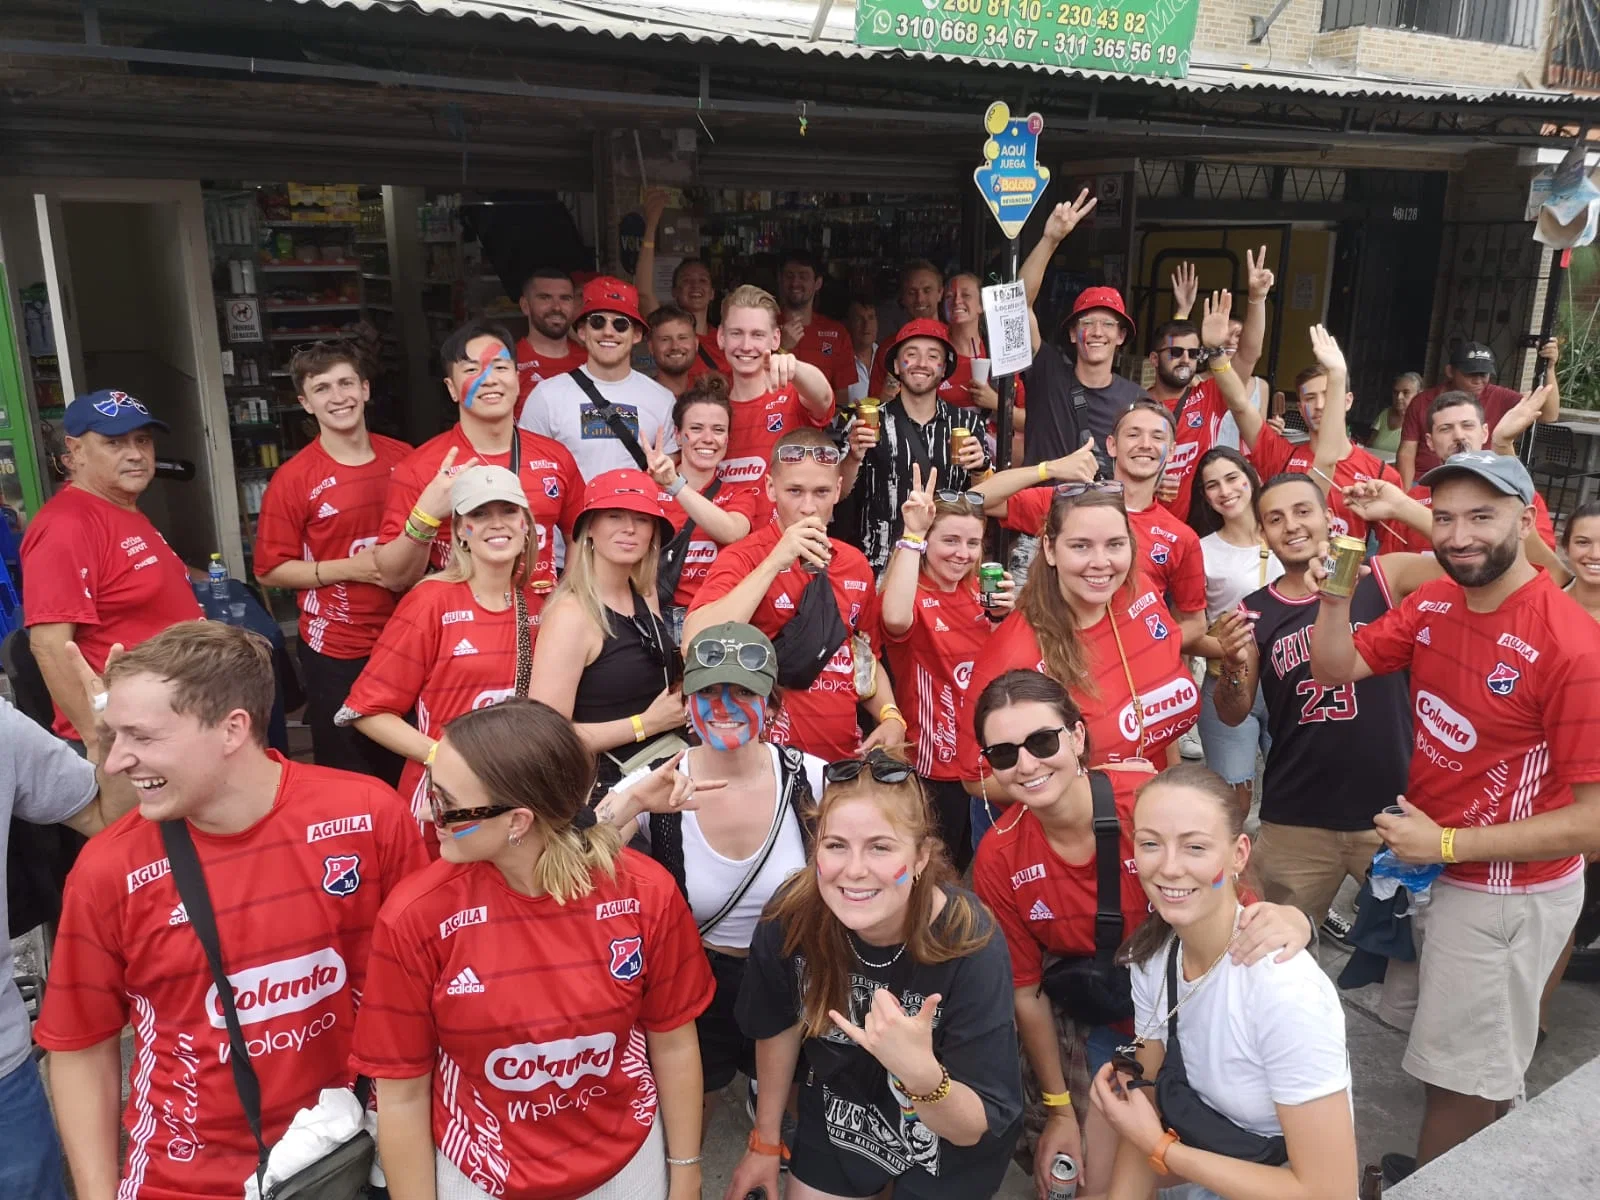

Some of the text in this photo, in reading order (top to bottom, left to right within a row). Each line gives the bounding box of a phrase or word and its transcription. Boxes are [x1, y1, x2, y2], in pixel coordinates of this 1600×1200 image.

[987, 0, 1010, 18] 81
[1018, 0, 1041, 21] 10
[1057, 3, 1092, 27] 230
[1096, 9, 1119, 30] 43
[1123, 12, 1146, 34] 82
[895, 14, 935, 39] 310
[940, 19, 979, 44] 668
[983, 24, 1009, 47] 34
[1013, 28, 1039, 50] 67
[1054, 32, 1088, 55] 311
[1092, 37, 1126, 60] 365
[1130, 41, 1152, 62] 56
[1156, 44, 1177, 64] 19
[999, 159, 1026, 169] JUEGA
[1000, 143, 1026, 157] AQUÍ
[1130, 594, 1155, 618] AGUILA
[1501, 636, 1536, 660] AGUILA
[1296, 678, 1359, 725] 23
[1418, 696, 1470, 747] Colanta
[311, 816, 369, 841] AGUILA
[131, 859, 171, 890] AGUIL
[446, 983, 485, 995] adidas
[854, 1136, 880, 1154] MASON
[886, 1153, 907, 1172] WATER
